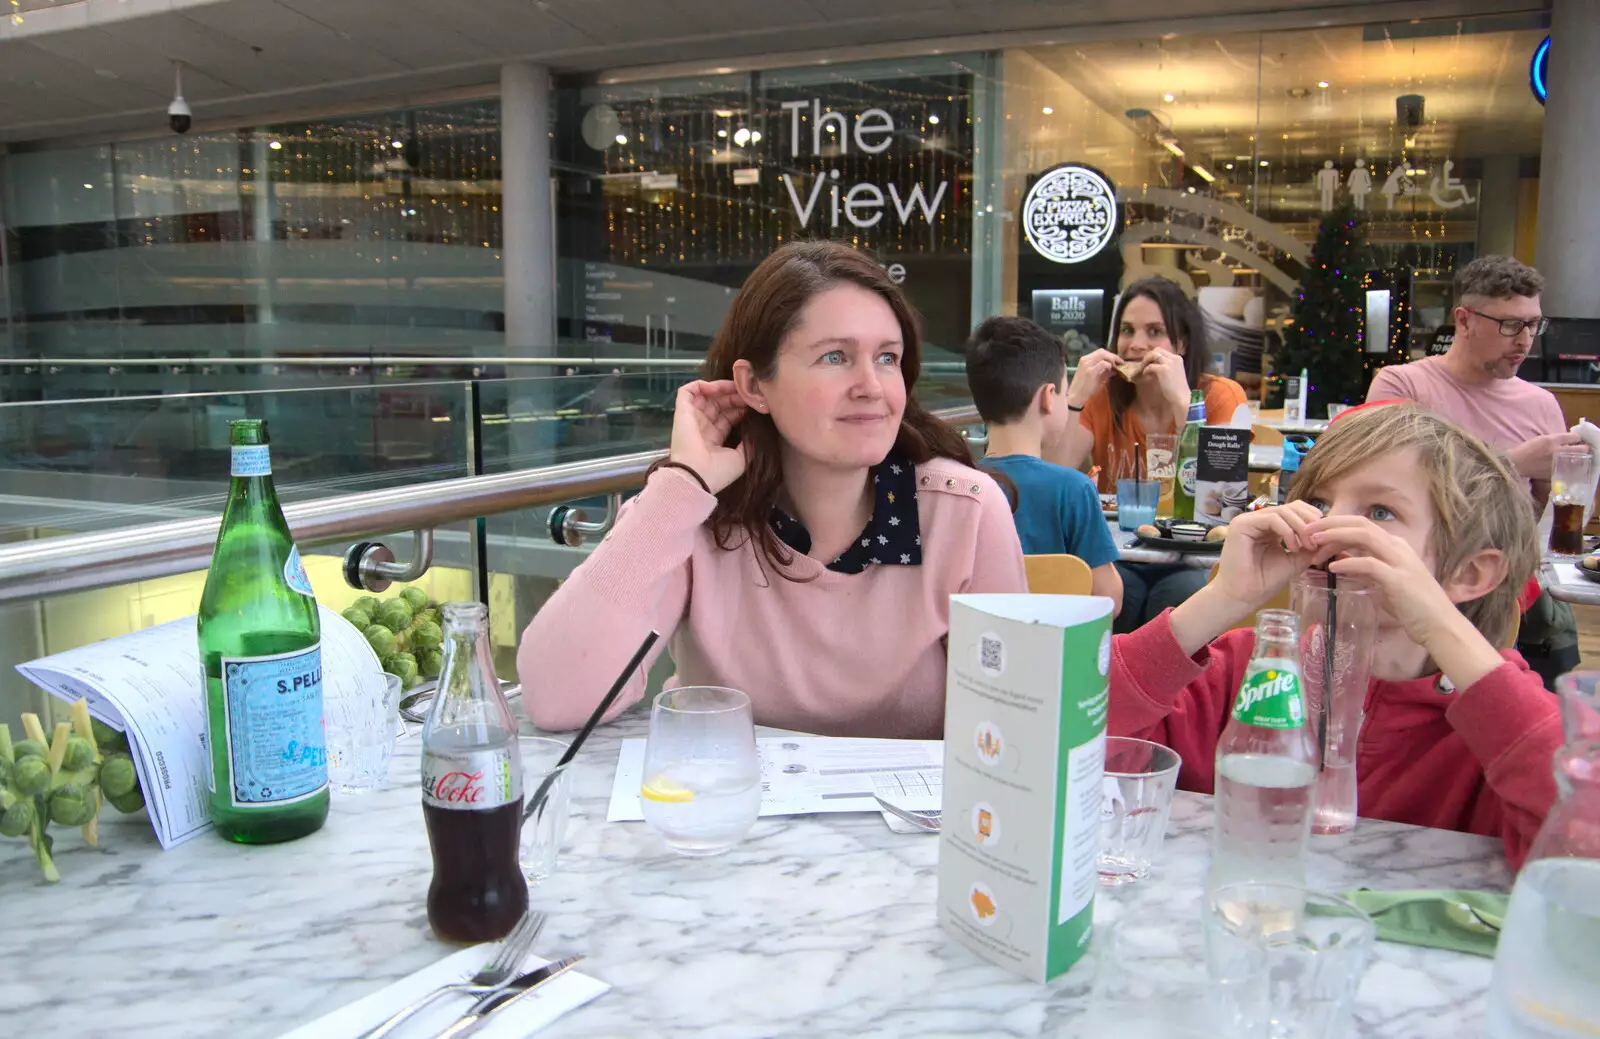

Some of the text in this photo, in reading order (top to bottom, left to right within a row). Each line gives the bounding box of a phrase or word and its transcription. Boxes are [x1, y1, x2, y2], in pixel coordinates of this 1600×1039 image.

[781, 98, 894, 157] The
[783, 169, 948, 228] View
[1047, 200, 1092, 213] PIZZA
[1033, 211, 1106, 227] EXPRESS
[1051, 297, 1086, 311] Balls
[1062, 311, 1086, 320] 2020
[1436, 335, 1455, 343] PLEA
[1208, 441, 1227, 449] Dough
[277, 665, 322, 694] S.PELL
[1236, 672, 1295, 713] Sprite
[155, 751, 172, 790] PROSECCO
[435, 771, 485, 804] Coke
